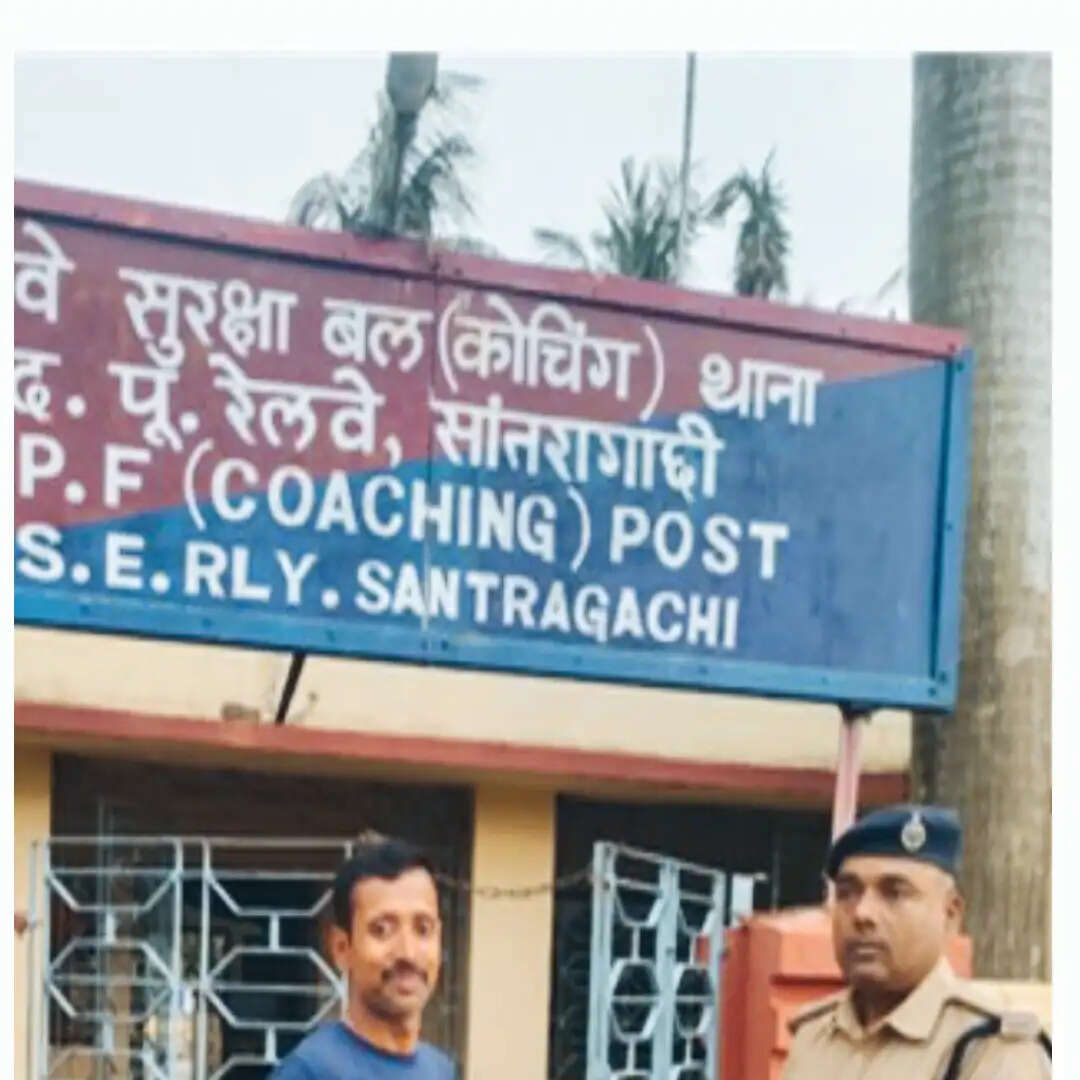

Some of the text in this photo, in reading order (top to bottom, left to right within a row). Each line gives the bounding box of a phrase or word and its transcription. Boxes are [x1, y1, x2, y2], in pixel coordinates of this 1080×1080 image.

[118, 267, 298, 366] सुरक्षा
[323, 299, 432, 372] बल
[438, 292, 665, 421] (कोचिंग)
[699, 353, 824, 427] थाना
[184, 438, 592, 574] (COACHING)
[609, 504, 790, 580] POST
[354, 559, 741, 650] SANTRAGACHI
